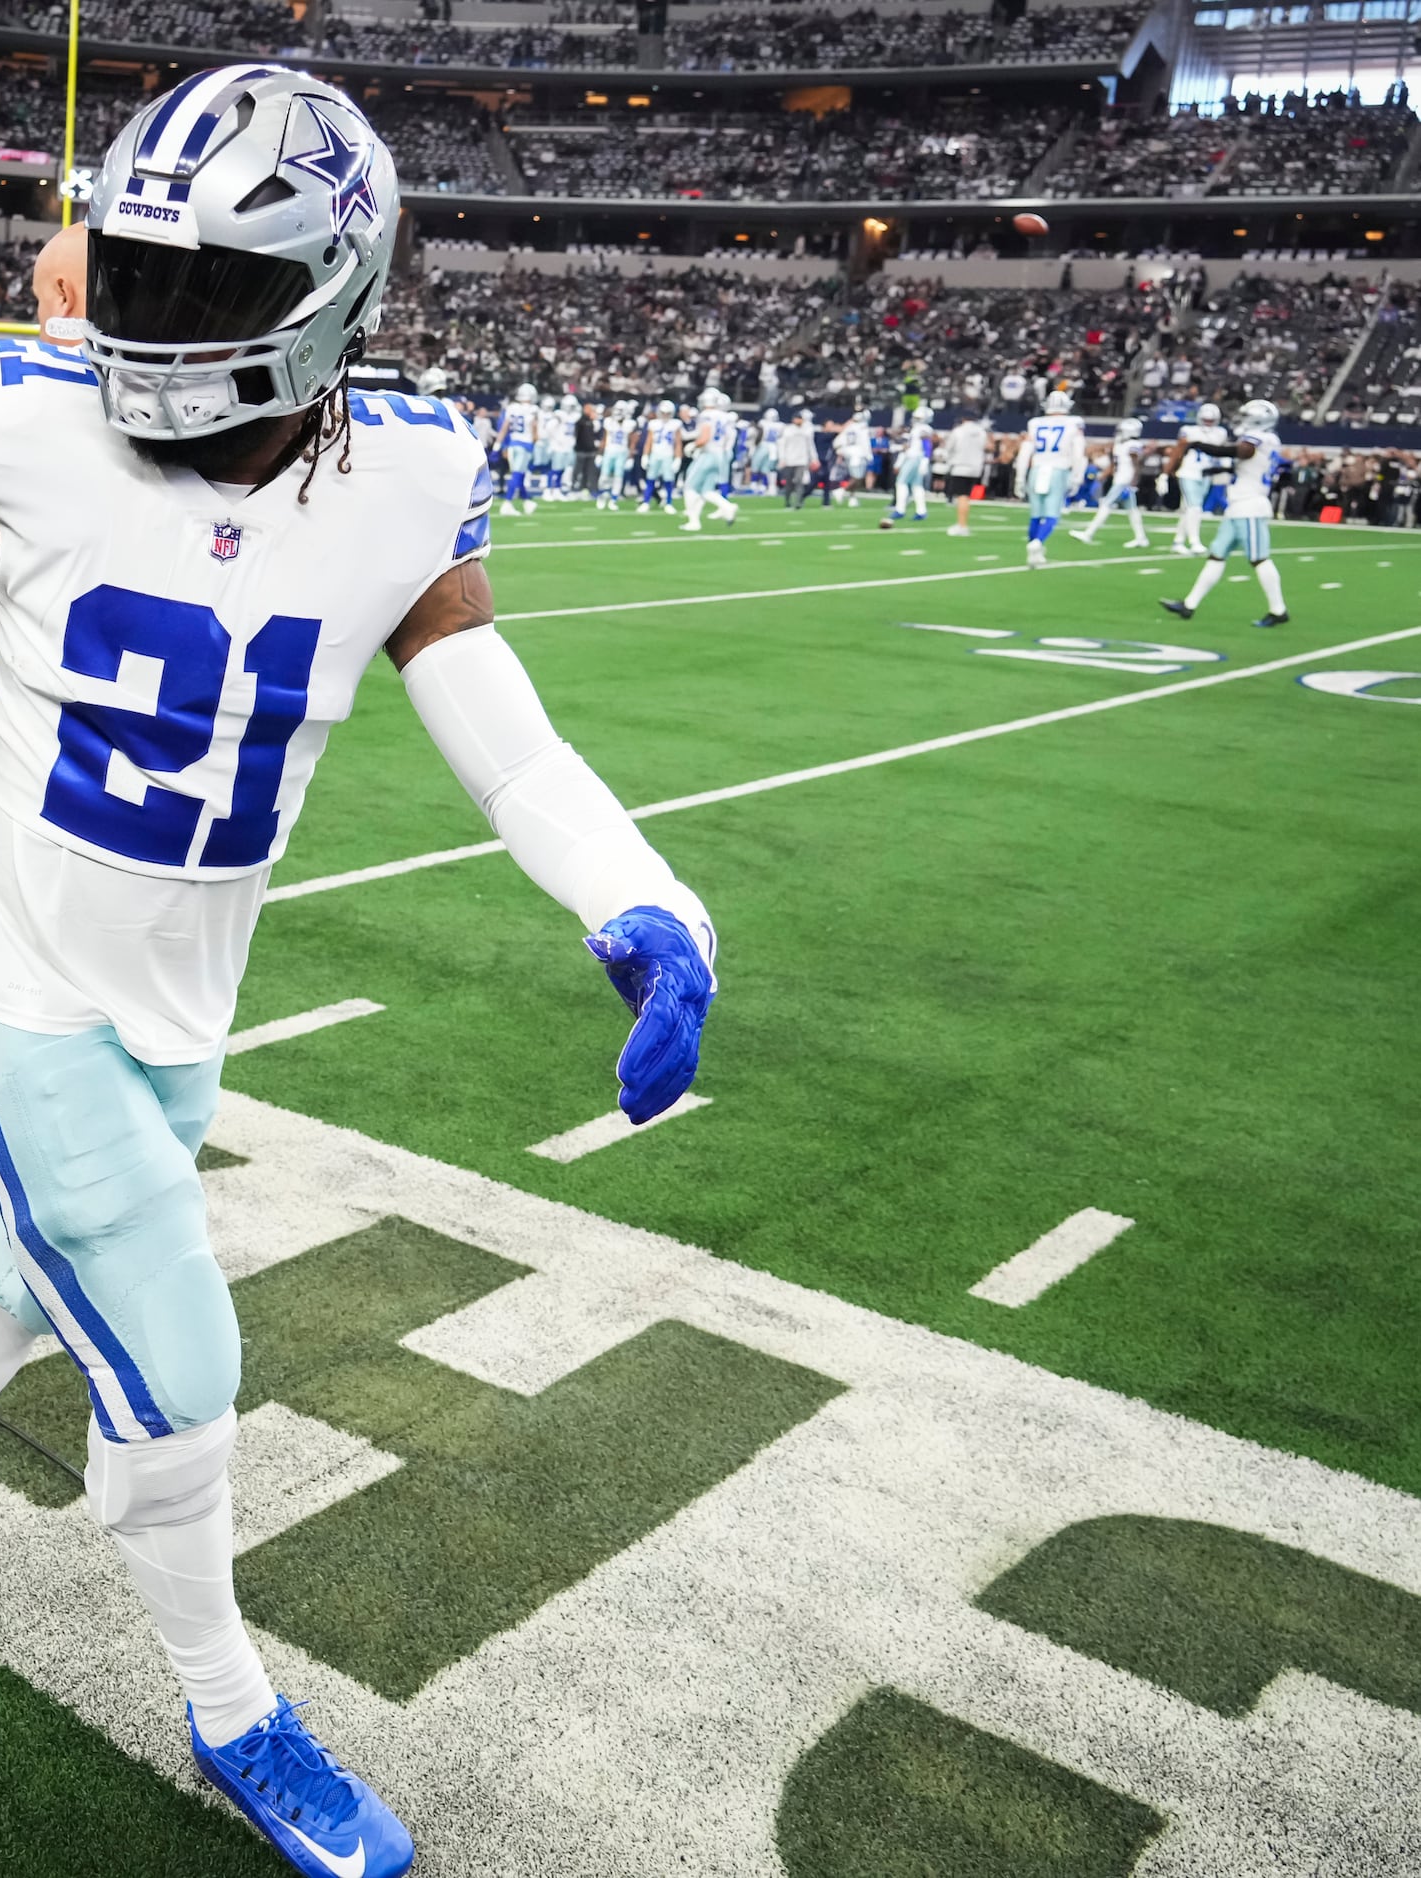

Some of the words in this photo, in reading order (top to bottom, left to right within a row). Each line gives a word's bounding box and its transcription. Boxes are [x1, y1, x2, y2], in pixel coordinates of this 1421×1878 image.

[119, 201, 180, 222] COWBOYS
[1036, 426, 1065, 453] 57
[214, 538, 236, 556] NFL
[39, 583, 322, 868] 21
